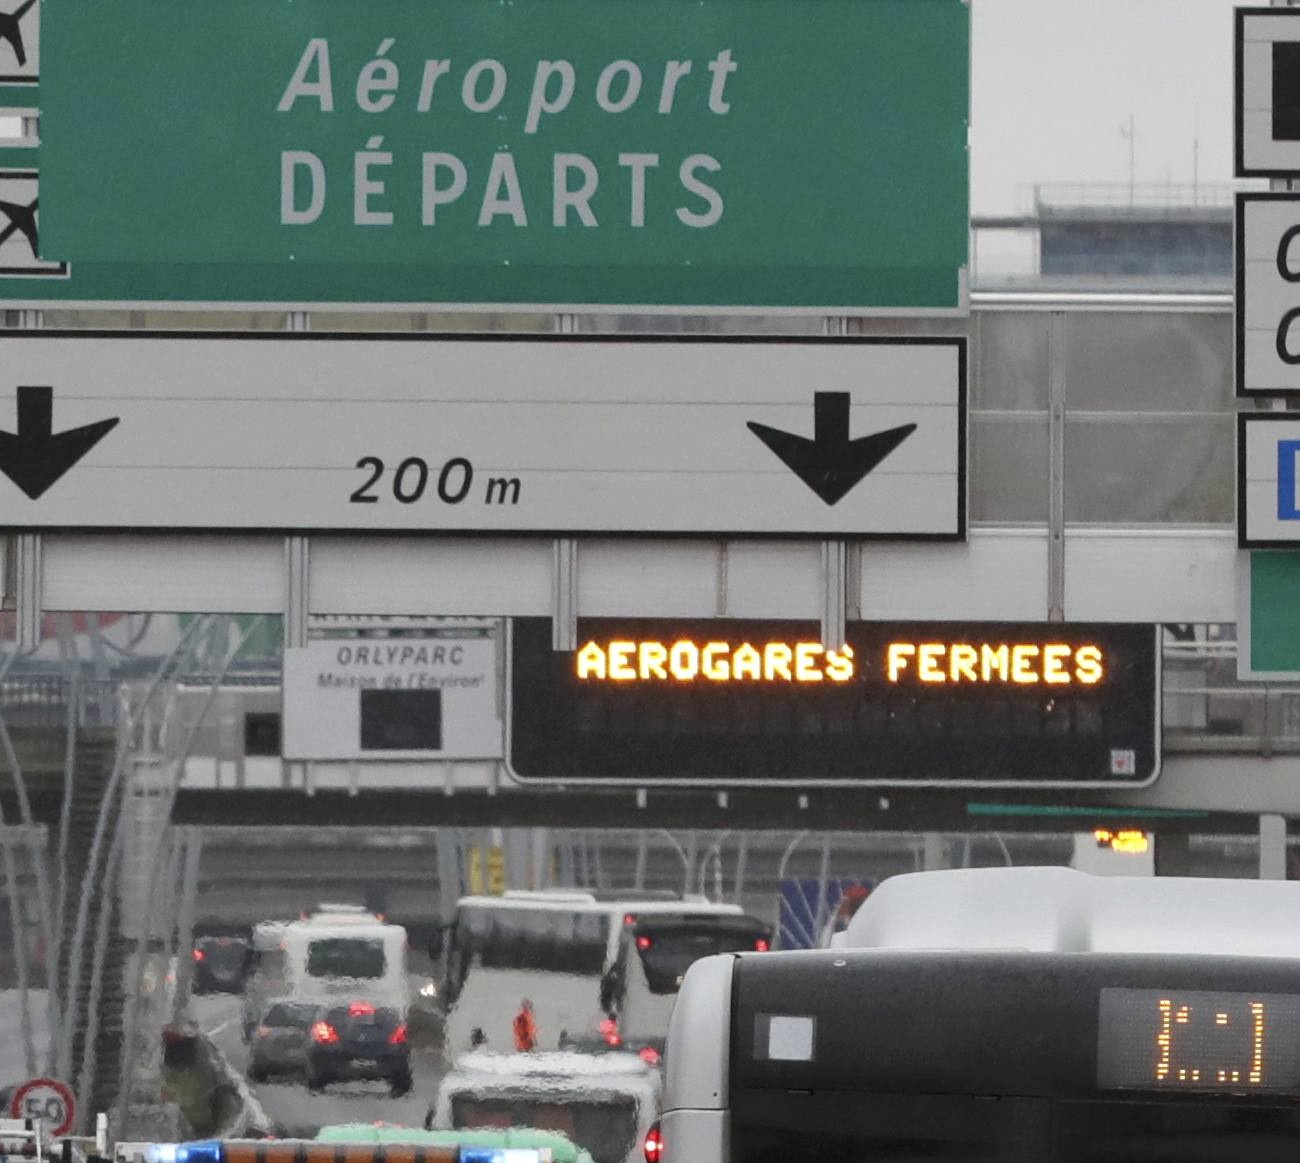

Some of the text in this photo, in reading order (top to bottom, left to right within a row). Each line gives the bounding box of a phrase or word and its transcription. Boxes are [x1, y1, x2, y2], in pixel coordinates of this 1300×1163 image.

[277, 37, 737, 134] Aéroport
[280, 136, 725, 229] DÉPARTS
[336, 645, 465, 666] ORLYPARC
[577, 640, 1104, 685] AEROGARES FERMEES
[317, 672, 377, 688] Maison
